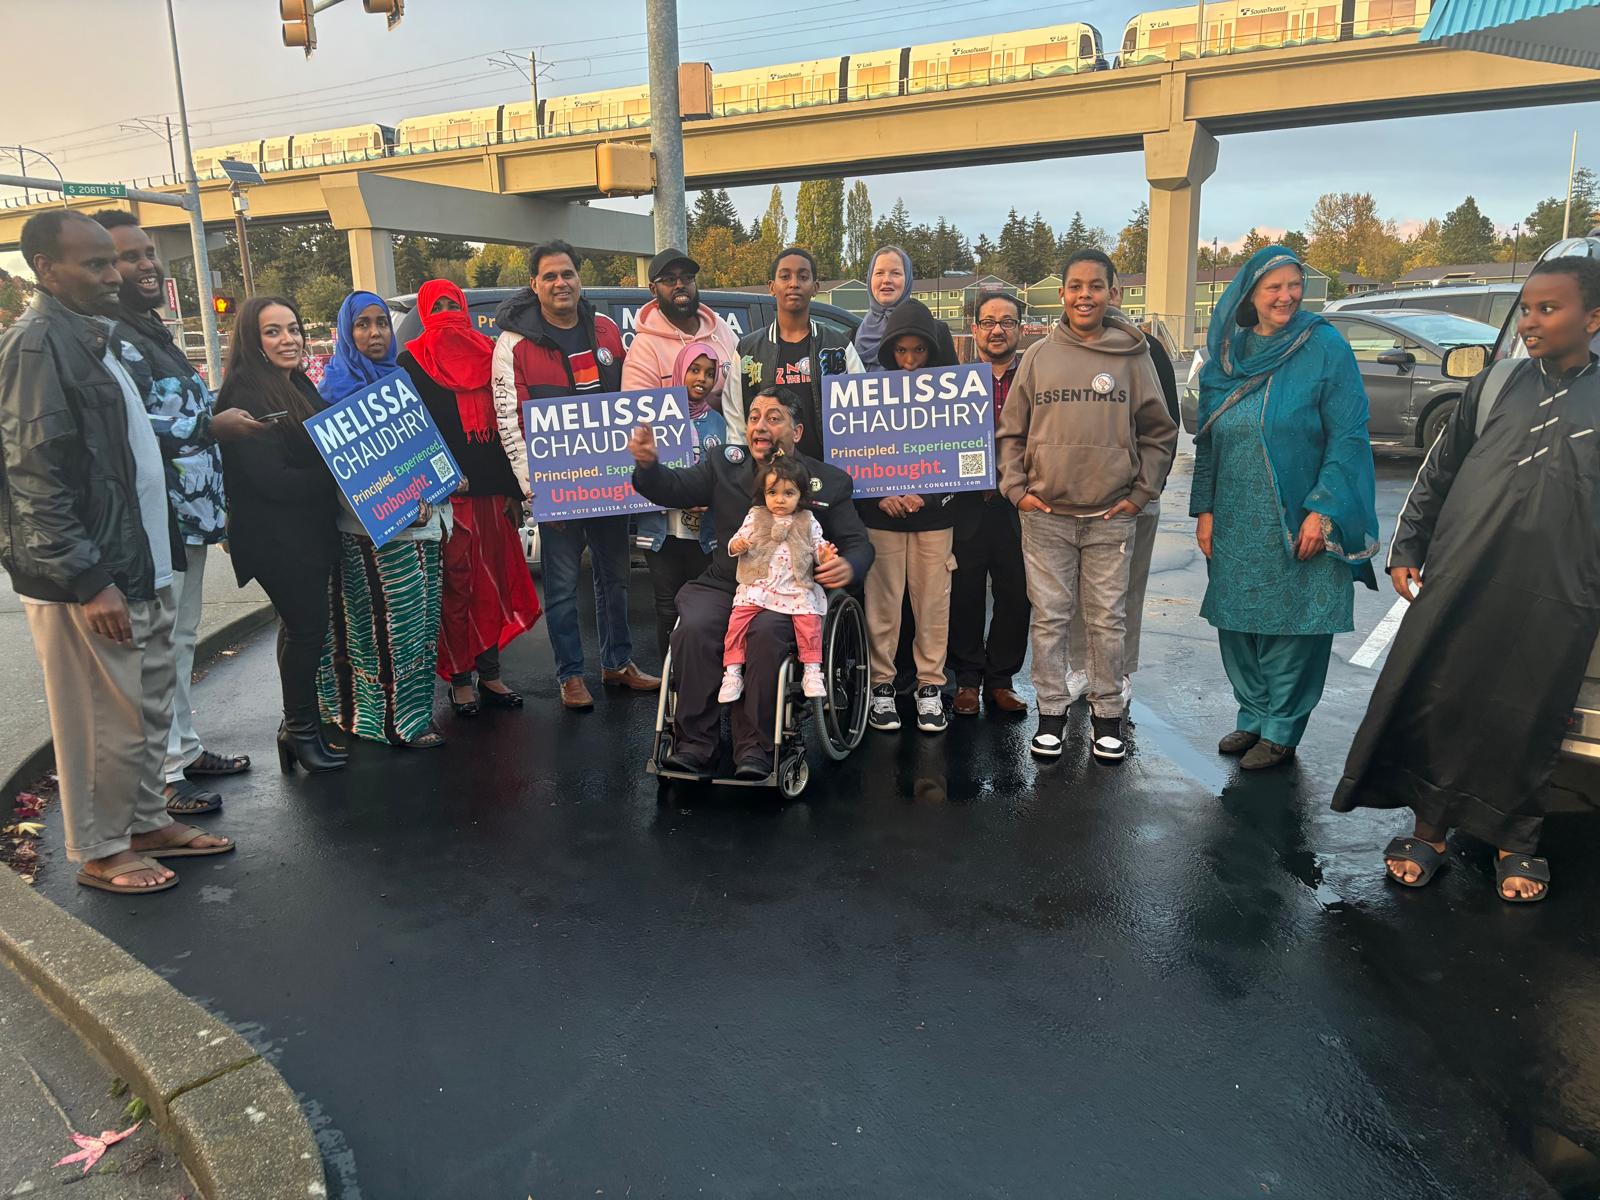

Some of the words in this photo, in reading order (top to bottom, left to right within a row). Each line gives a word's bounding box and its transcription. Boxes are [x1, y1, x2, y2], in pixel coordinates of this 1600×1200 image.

[69, 185, 75, 194] S
[78, 185, 107, 194] 208TH
[110, 186, 120, 195] ST
[830, 370, 988, 409] MELISSA
[1035, 388, 1127, 405] ESSENTIALS
[314, 378, 418, 454] MELISSA
[531, 393, 685, 433] MELISSA
[829, 401, 989, 436] CHAUDHRY
[333, 405, 429, 480] CHAUDHRY
[531, 423, 686, 459] CHAUDRY
[830, 443, 900, 460] Principled.
[903, 437, 988, 456] Experienced.
[352, 470, 397, 506] Principled.
[394, 439, 443, 477] Experienced.
[534, 466, 602, 483] Principled.
[846, 459, 947, 481] Unbought.
[924, 481, 961, 489] CONGRESS
[372, 473, 433, 522] Unbought.
[551, 479, 636, 504] Unbough
[592, 504, 620, 512] MELISSA
